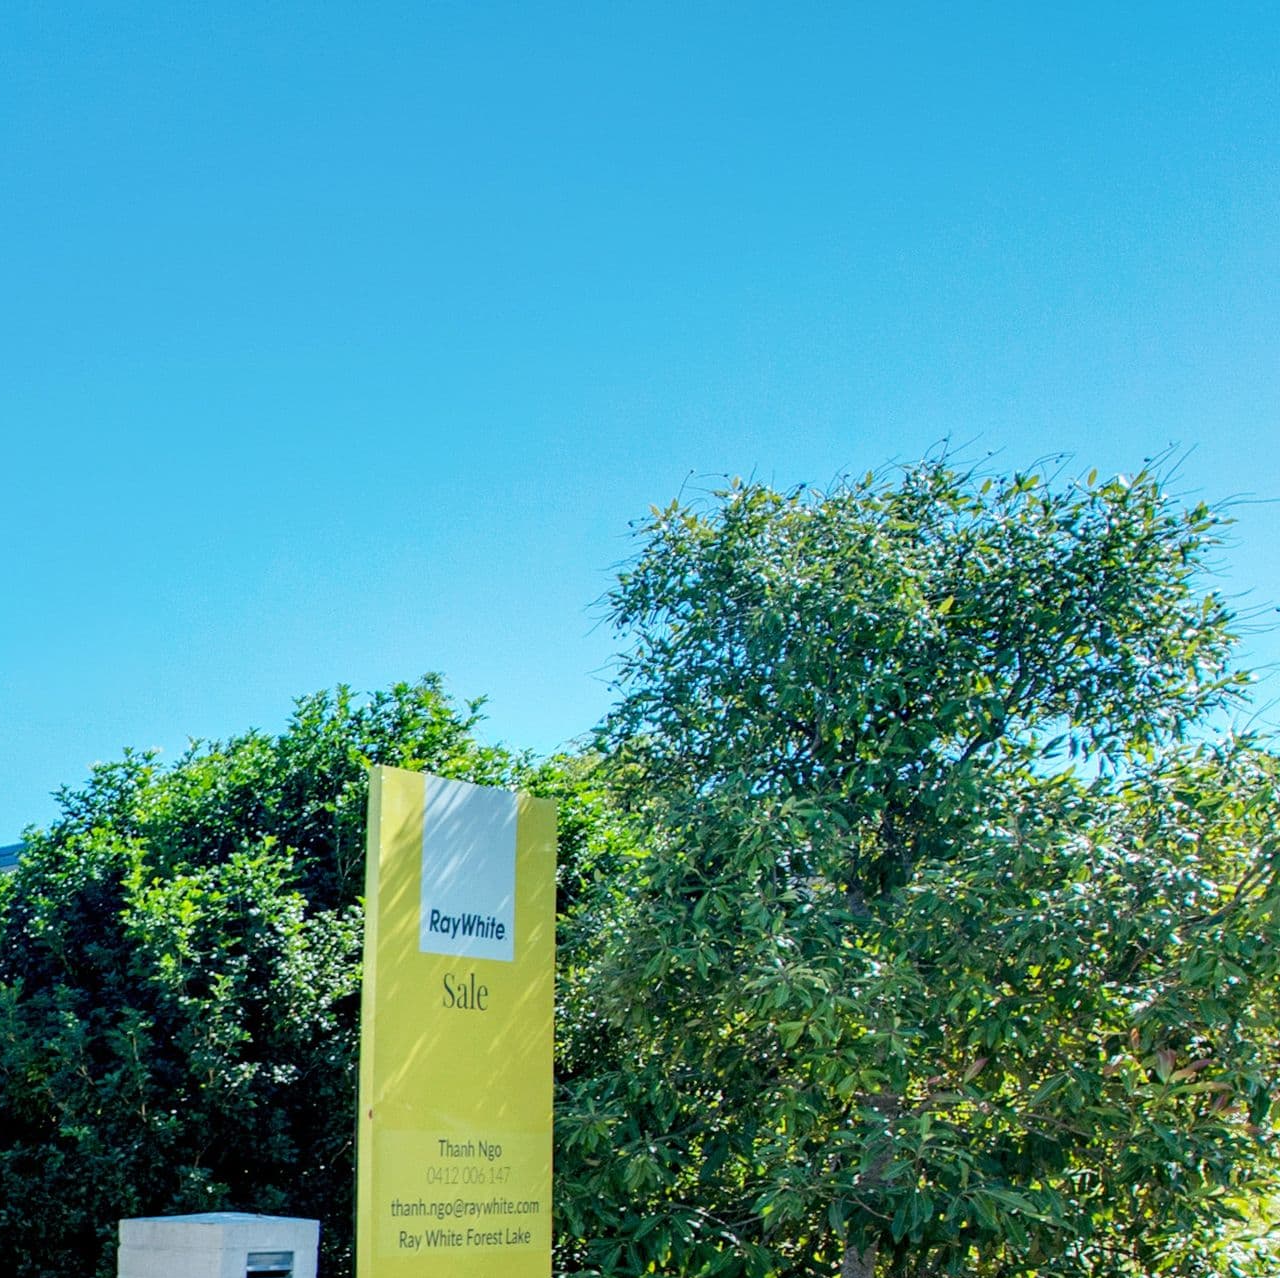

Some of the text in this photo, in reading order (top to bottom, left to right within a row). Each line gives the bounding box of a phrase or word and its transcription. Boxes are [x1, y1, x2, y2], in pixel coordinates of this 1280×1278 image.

[429, 909, 506, 941] RayWhite
[442, 972, 488, 1011] Sale
[438, 1139, 502, 1161] Thanh Ngo
[426, 1166, 459, 1185] 0412
[489, 1166, 512, 1184] 147
[391, 1198, 539, 1219] thanh.ngo@raywhite.com
[399, 1226, 532, 1250] Ray White Forest Lake
